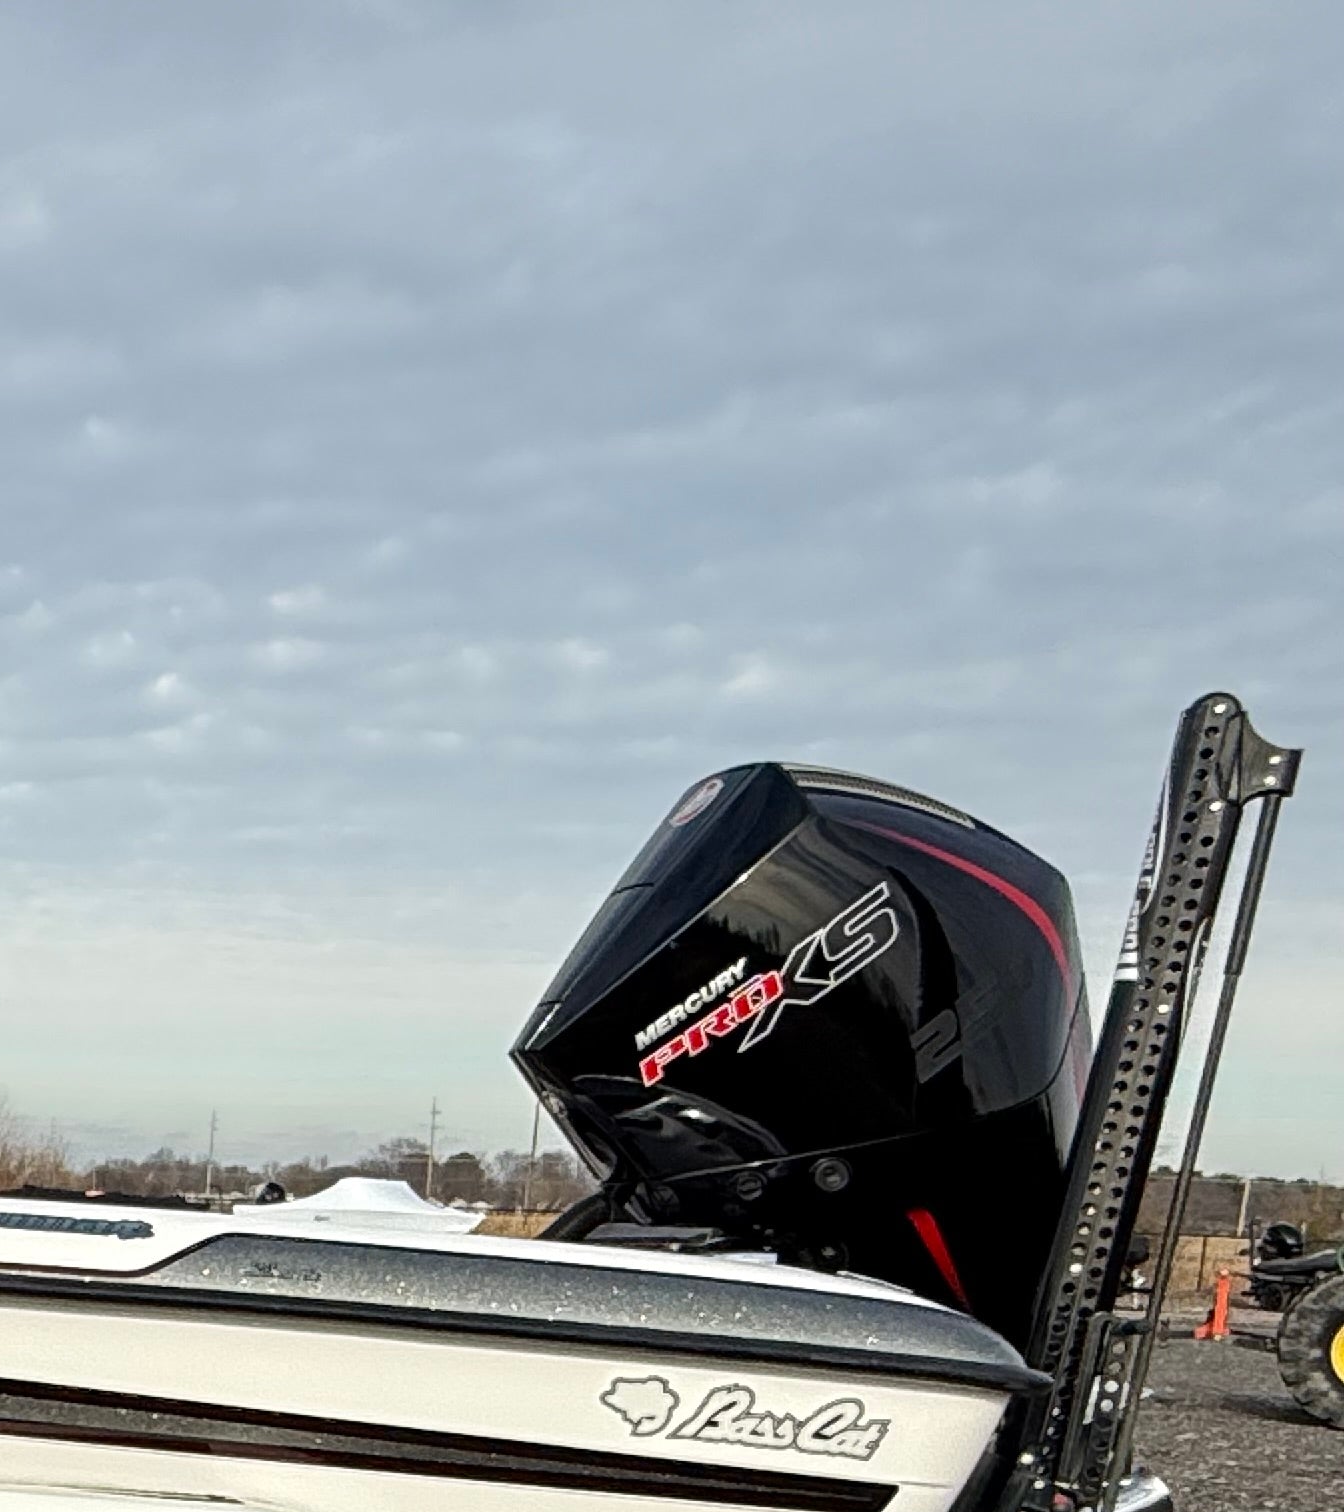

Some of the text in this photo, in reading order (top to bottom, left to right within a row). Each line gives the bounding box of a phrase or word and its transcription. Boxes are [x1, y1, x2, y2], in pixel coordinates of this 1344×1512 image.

[634, 956, 748, 1051] MERCURY
[639, 880, 900, 1087] PRO XS
[665, 1383, 892, 1461] Bass Cat
